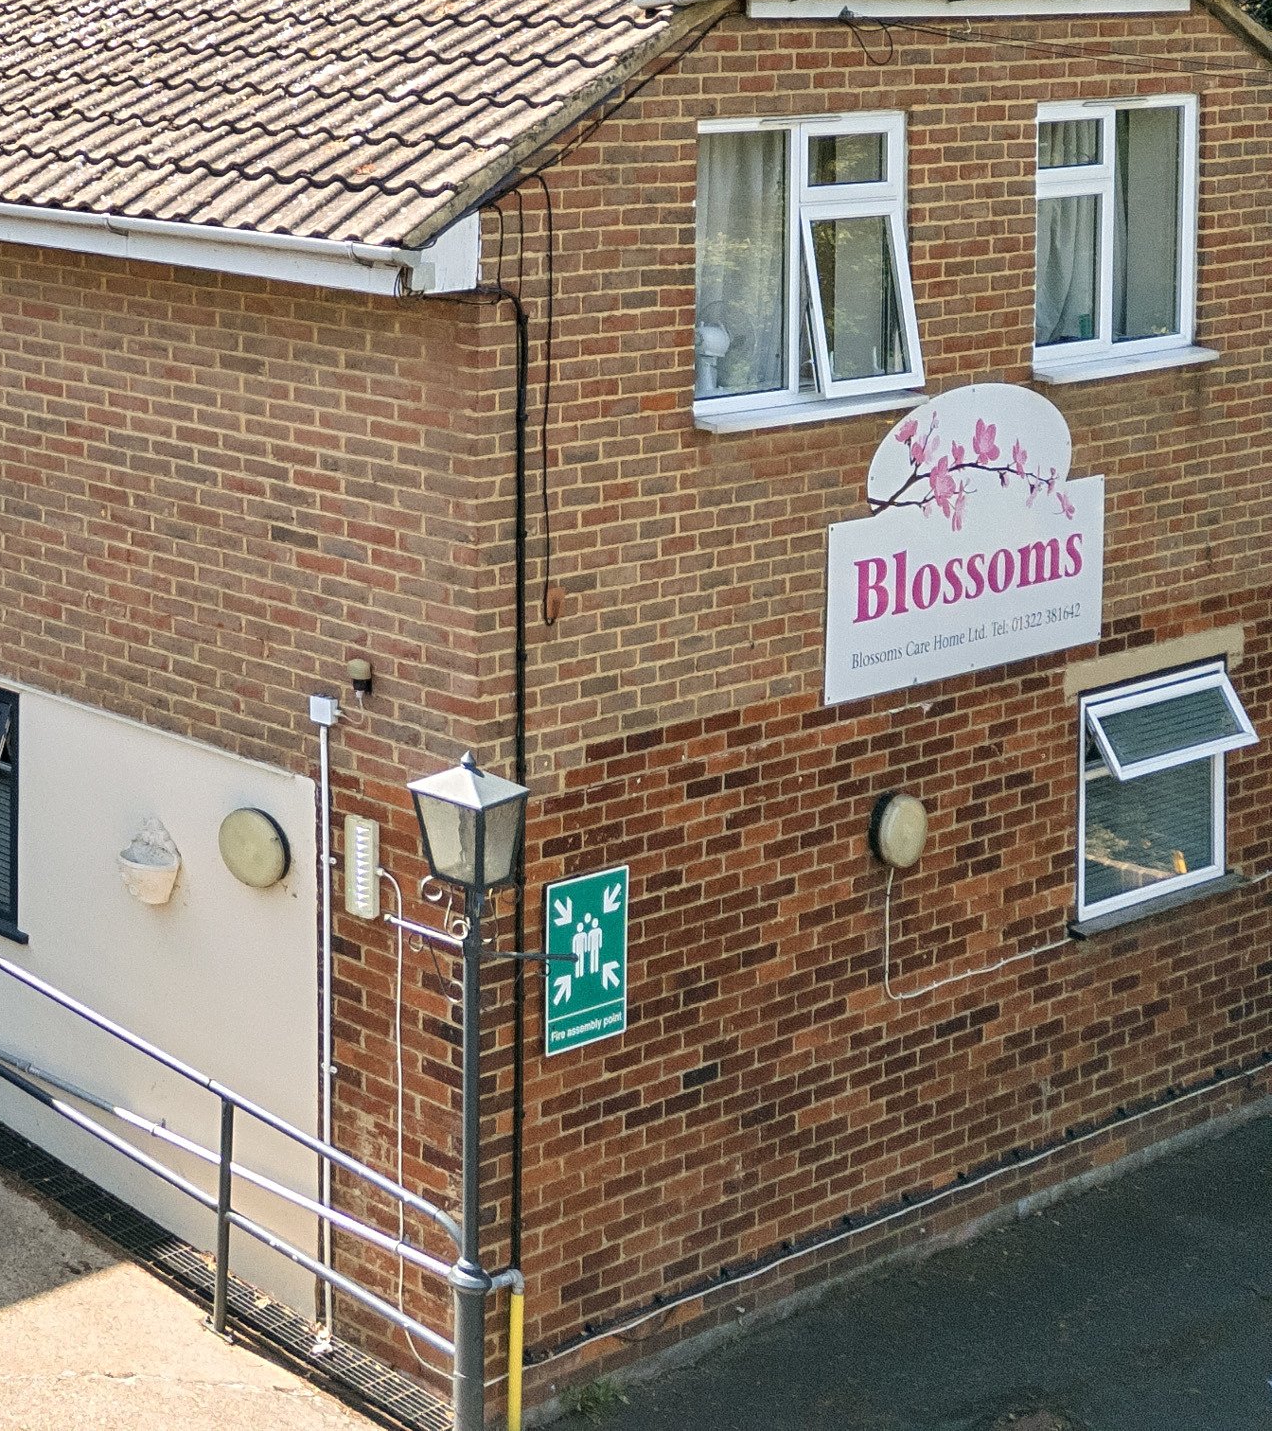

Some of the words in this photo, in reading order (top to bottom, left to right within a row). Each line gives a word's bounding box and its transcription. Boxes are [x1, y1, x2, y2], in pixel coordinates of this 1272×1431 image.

[853, 533, 1083, 624] Blossoms
[852, 647, 903, 669] Blossoms
[906, 640, 931, 657] Care
[933, 632, 965, 651] Home
[968, 624, 988, 643] Ltd.
[1011, 611, 1042, 632] 01322
[551, 1030, 565, 1042] Fire
[567, 1018, 602, 1037] assembly
[603, 1011, 622, 1028] point
